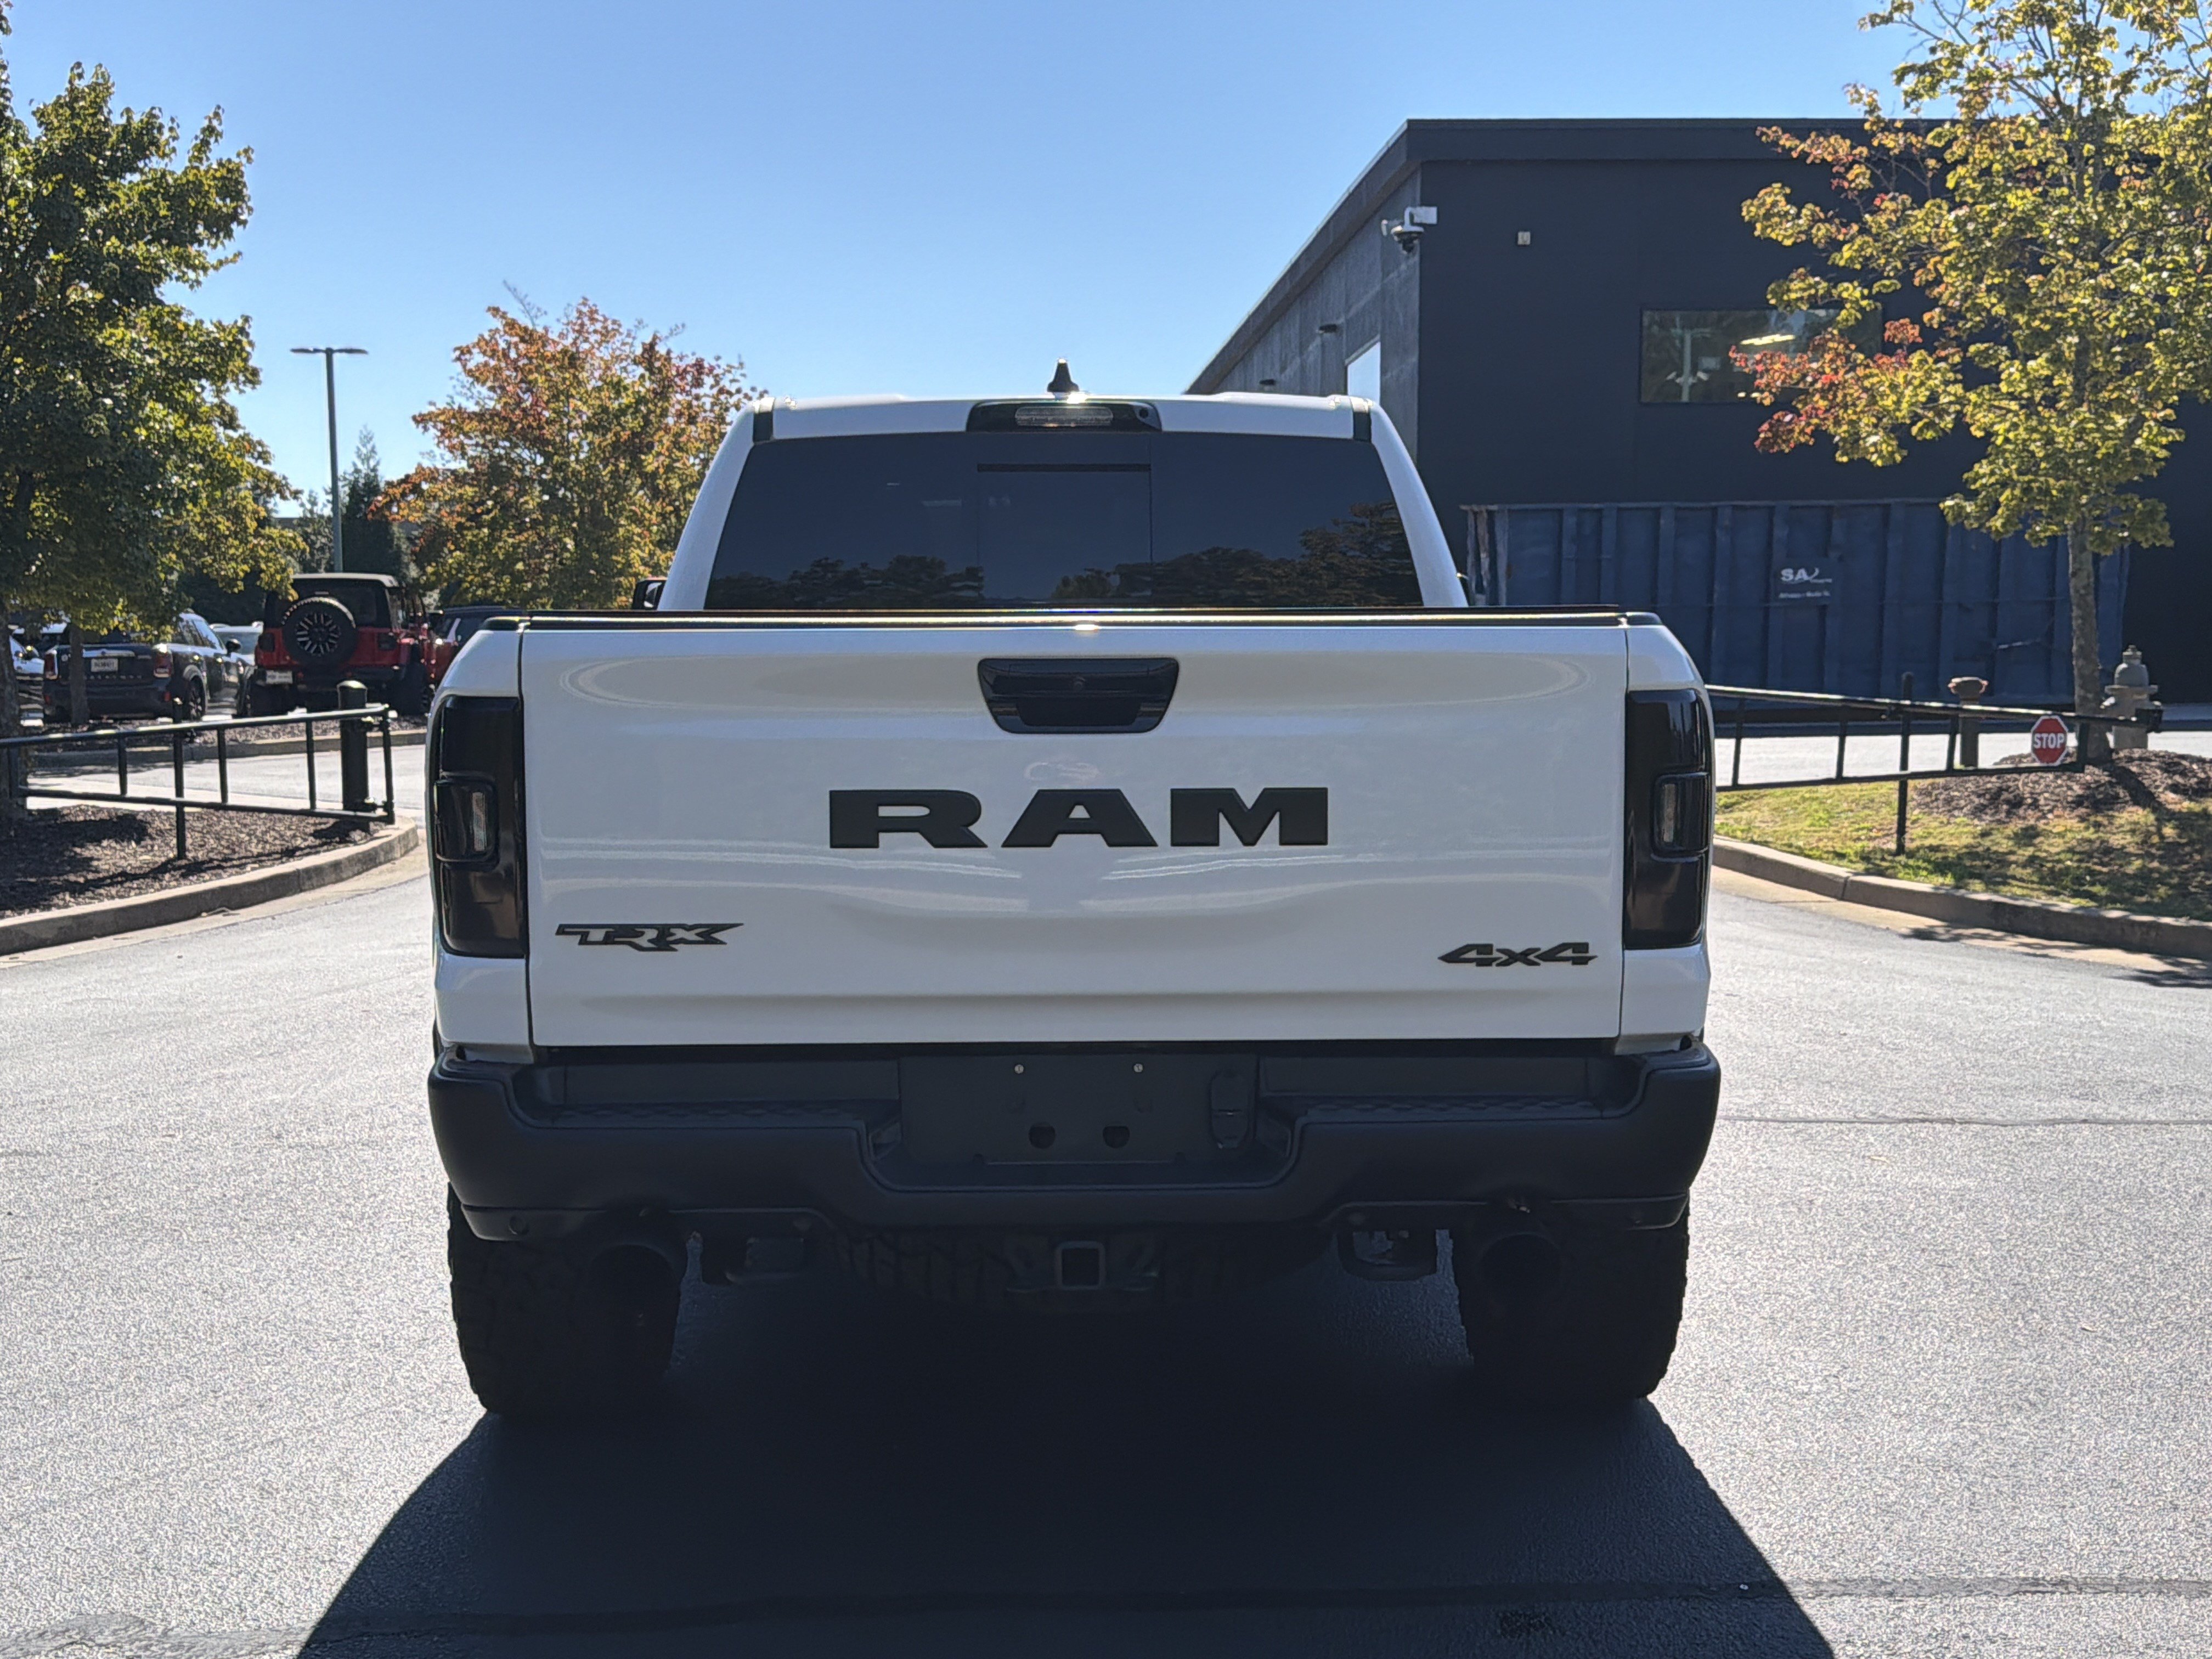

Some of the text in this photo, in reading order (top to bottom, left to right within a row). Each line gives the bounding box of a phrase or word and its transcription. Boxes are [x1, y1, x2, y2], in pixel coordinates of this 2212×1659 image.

[2034, 733, 2064, 749] STOP
[829, 787, 1328, 849] RAM
[555, 923, 744, 952] TRX
[1437, 942, 1598, 967] 4x4
